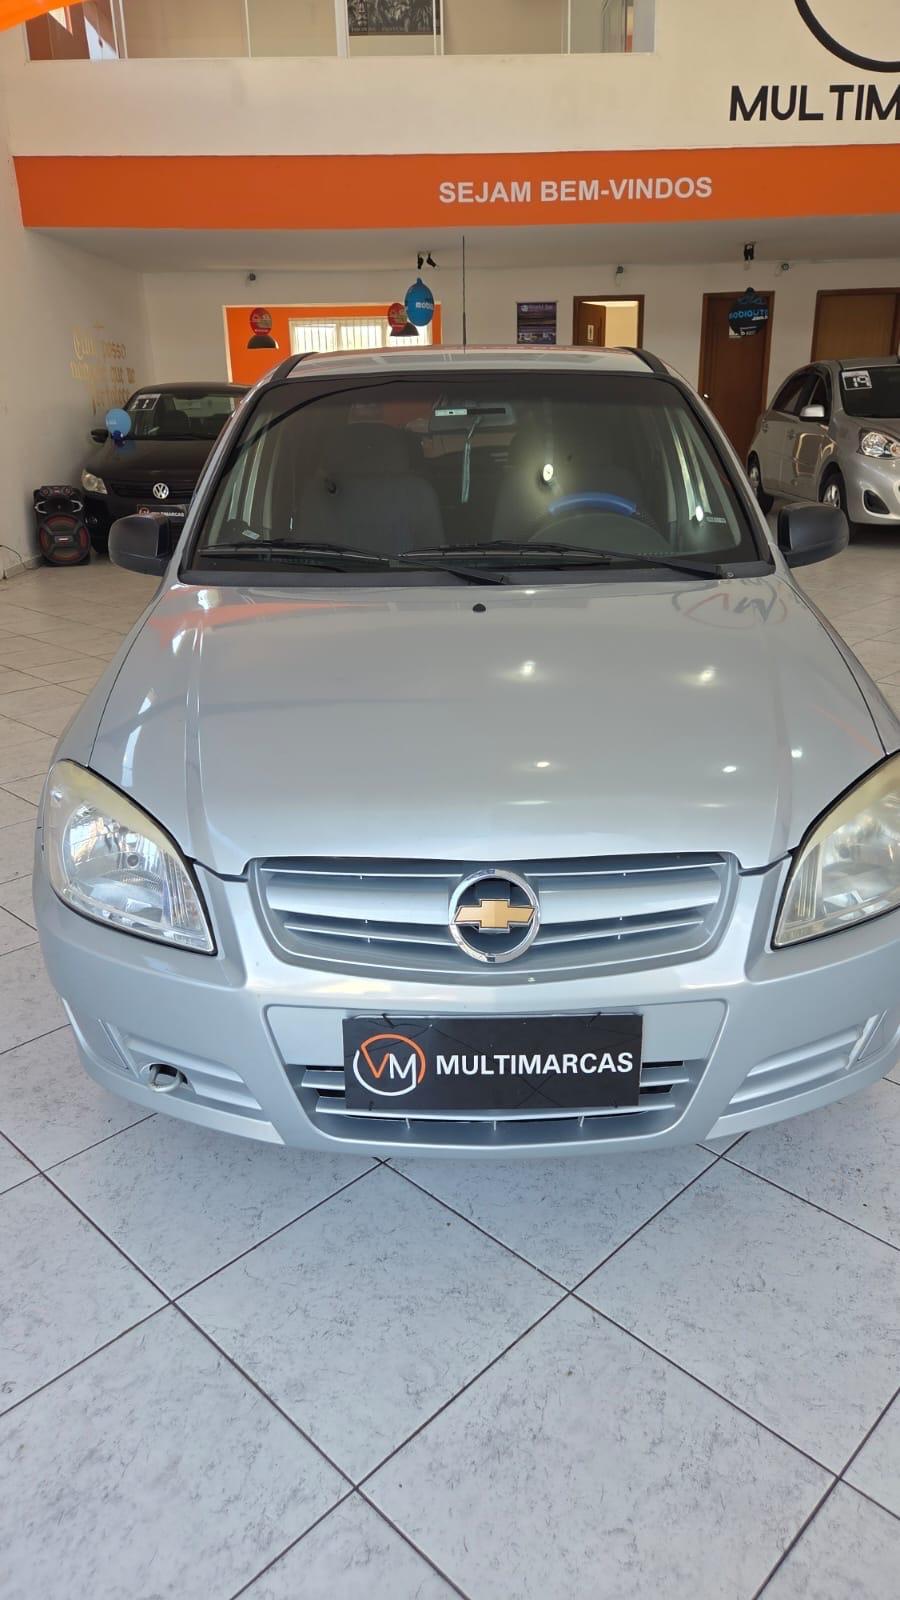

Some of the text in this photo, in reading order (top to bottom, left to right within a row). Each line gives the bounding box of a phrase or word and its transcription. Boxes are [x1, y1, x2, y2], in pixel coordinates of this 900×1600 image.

[729, 84, 900, 121] MULTIM
[439, 176, 713, 203] SEJAM BEM-VINDOS
[360, 1043, 634, 1088] VM MULTIMARCAS
